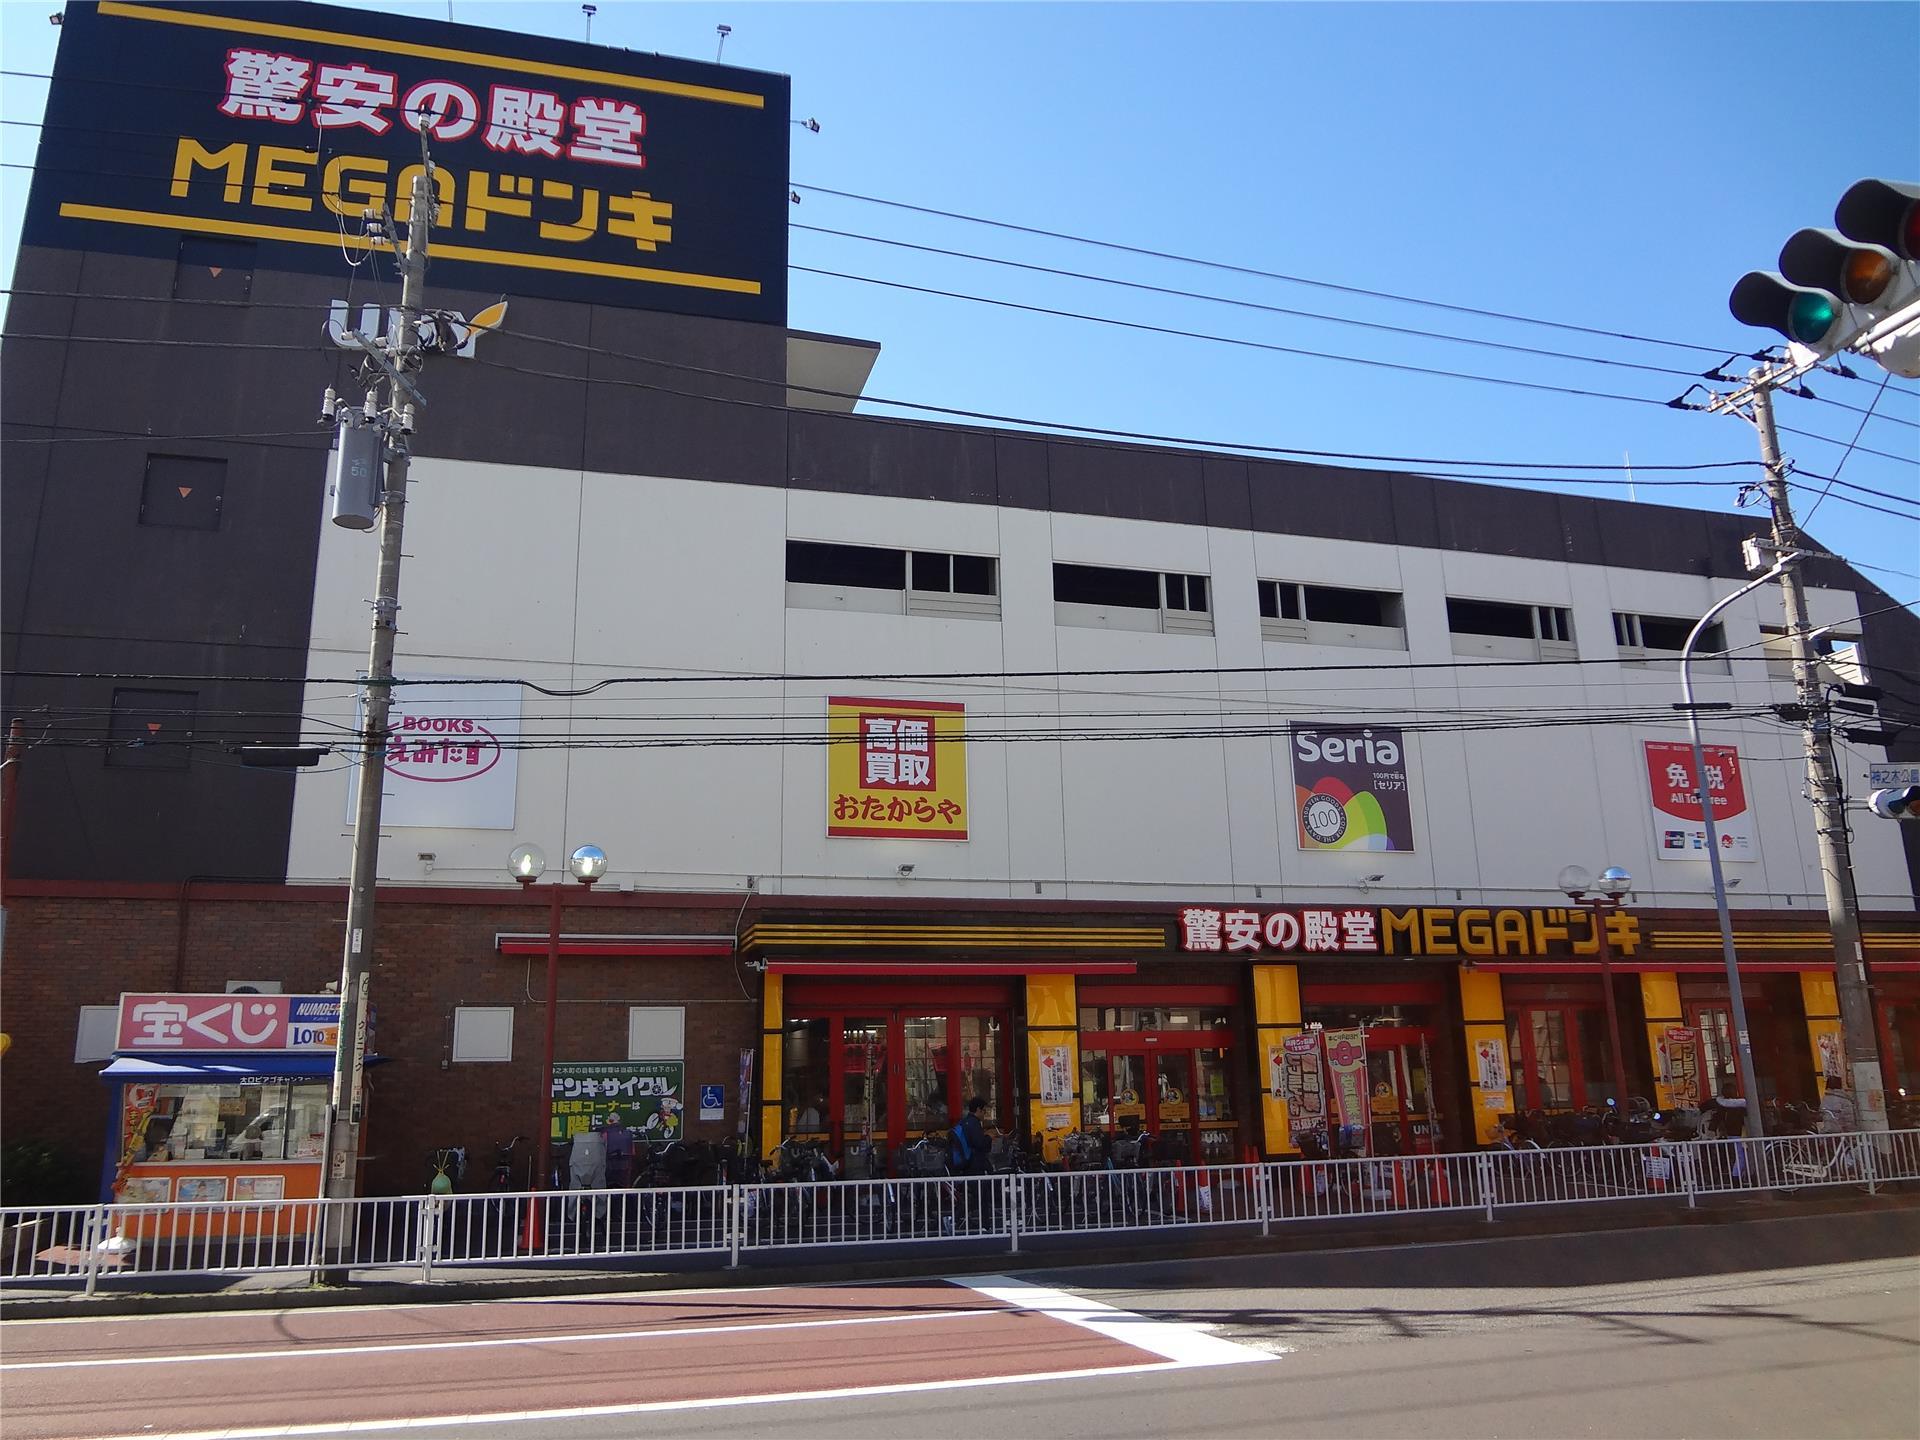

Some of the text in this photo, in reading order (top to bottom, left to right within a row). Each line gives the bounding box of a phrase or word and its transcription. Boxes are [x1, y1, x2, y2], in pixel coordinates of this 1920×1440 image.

[220, 48, 647, 168] 驚安の殿堂
[169, 136, 673, 251] MEGAドンキ
[403, 716, 474, 733] BOOKS
[865, 718, 929, 752] 高価
[1296, 729, 1399, 765] Seria
[865, 752, 931, 785] 買取
[1665, 763, 1725, 790] 免税
[833, 794, 962, 824] おたからや
[1671, 792, 1684, 804] All
[1311, 809, 1338, 829] 100
[1181, 907, 1641, 956] 驚安の殿堂 MEGAドンキ
[132, 1000, 278, 1046] 宝くじ
[296, 1002, 340, 1016] NUMBER
[293, 1026, 325, 1045] LOTO
[552, 1065, 678, 1074] 之木町の自転車修理は当店にお任せ下さい
